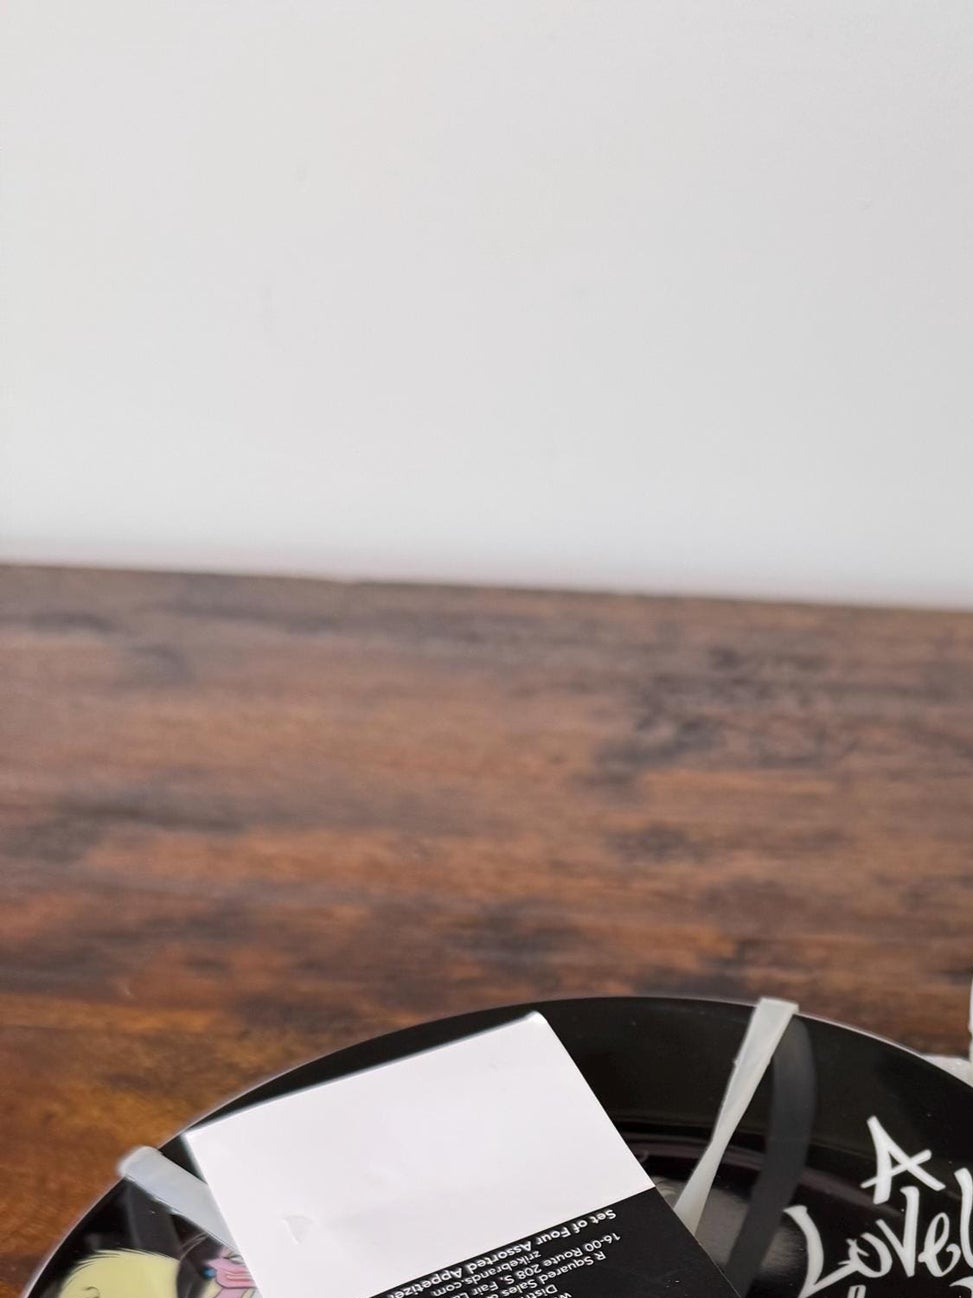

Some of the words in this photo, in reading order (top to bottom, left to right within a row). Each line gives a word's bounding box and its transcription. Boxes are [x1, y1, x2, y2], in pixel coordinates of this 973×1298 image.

[861, 1115, 946, 1204] A
[572, 1220, 588, 1233] of
[590, 1209, 616, 1225] Set
[536, 1226, 571, 1245] Four
[584, 1232, 620, 1252] 16-00
[466, 1241, 531, 1274] Assorted
[543, 1247, 582, 1267] Route
[594, 1250, 606, 1260] R
[432, 1250, 541, 1298] zrikebrands.com
[499, 1274, 514, 1284] S.
[516, 1263, 542, 1279] 208
[538, 1256, 594, 1284] Squared
[472, 1281, 498, 1296] Fair
[502, 1278, 537, 1297] Sales
